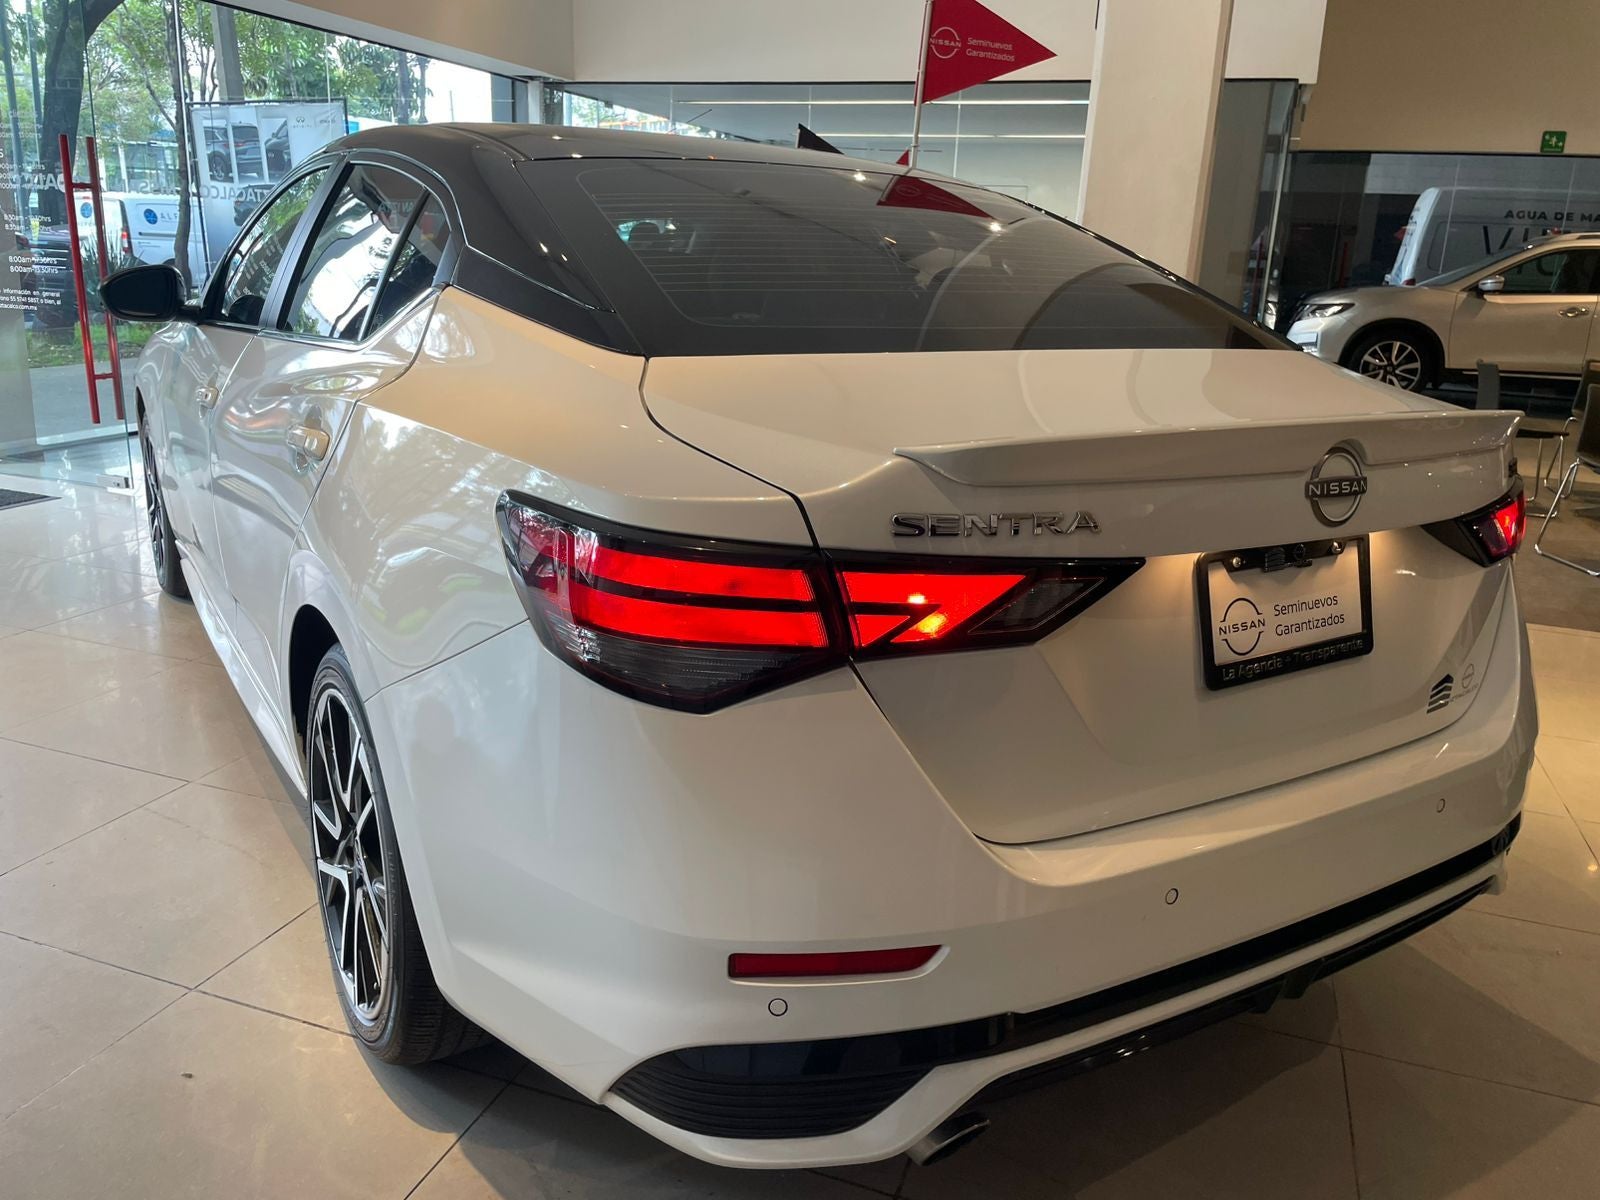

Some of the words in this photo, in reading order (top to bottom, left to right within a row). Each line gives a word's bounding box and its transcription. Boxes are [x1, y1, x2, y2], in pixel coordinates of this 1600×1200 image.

[929, 37, 962, 47] NISSAN
[967, 37, 1014, 51] Seminuevos
[965, 48, 1016, 62] Garantizados
[1504, 209, 1548, 221] AGUA
[1554, 211, 1575, 222] DE
[1307, 477, 1368, 496] NISSAN
[891, 511, 1102, 538] SENTRA
[1273, 594, 1339, 617] Seminuevos
[1218, 617, 1266, 636] NISSAN
[1275, 613, 1346, 637] Garantizados
[1222, 668, 1236, 681] La
[1238, 655, 1285, 679] Agencia
[1292, 638, 1364, 661] Transparente
